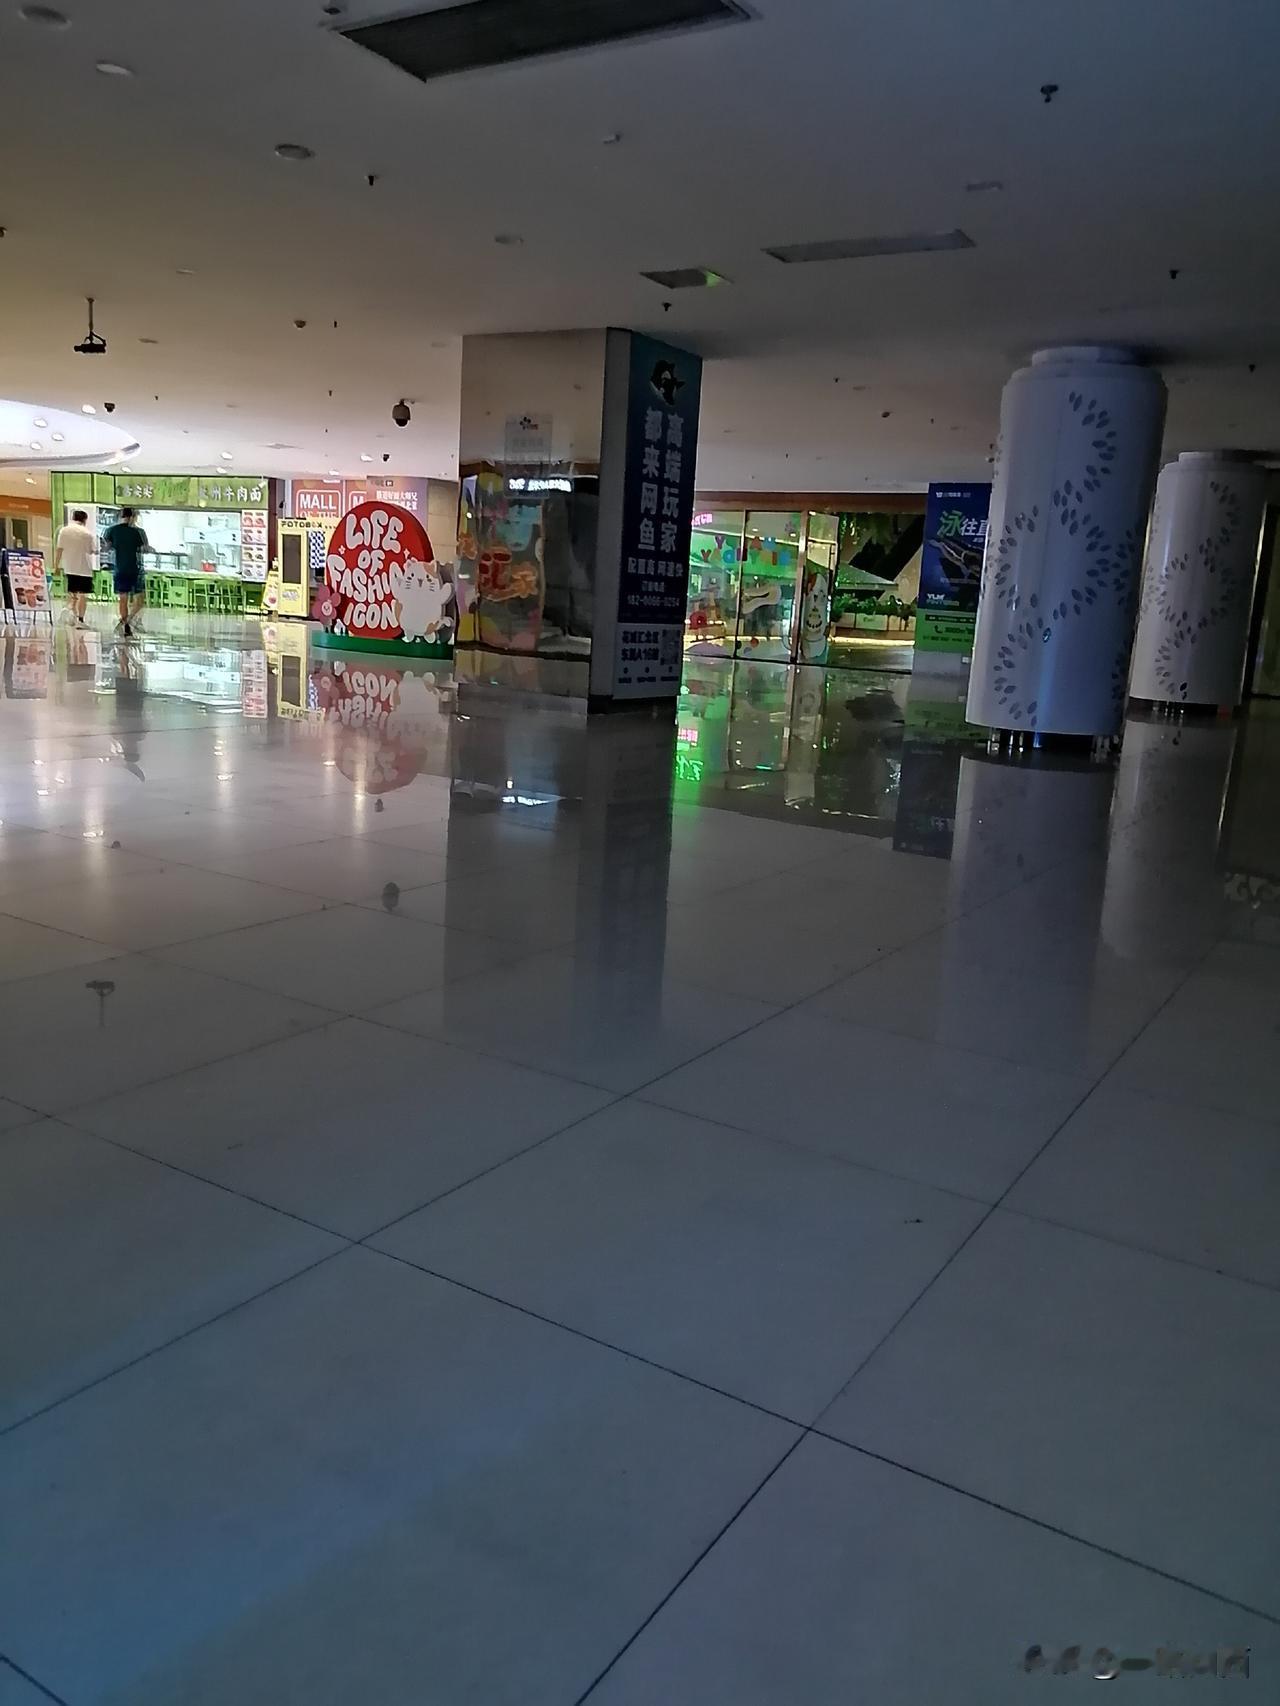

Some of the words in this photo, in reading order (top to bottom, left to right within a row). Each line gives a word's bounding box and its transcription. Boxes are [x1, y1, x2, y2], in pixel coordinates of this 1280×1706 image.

[300, 493, 336, 510] MALL
[345, 510, 404, 554] LIFE
[357, 550, 386, 578] OF
[343, 599, 400, 631] ICON
